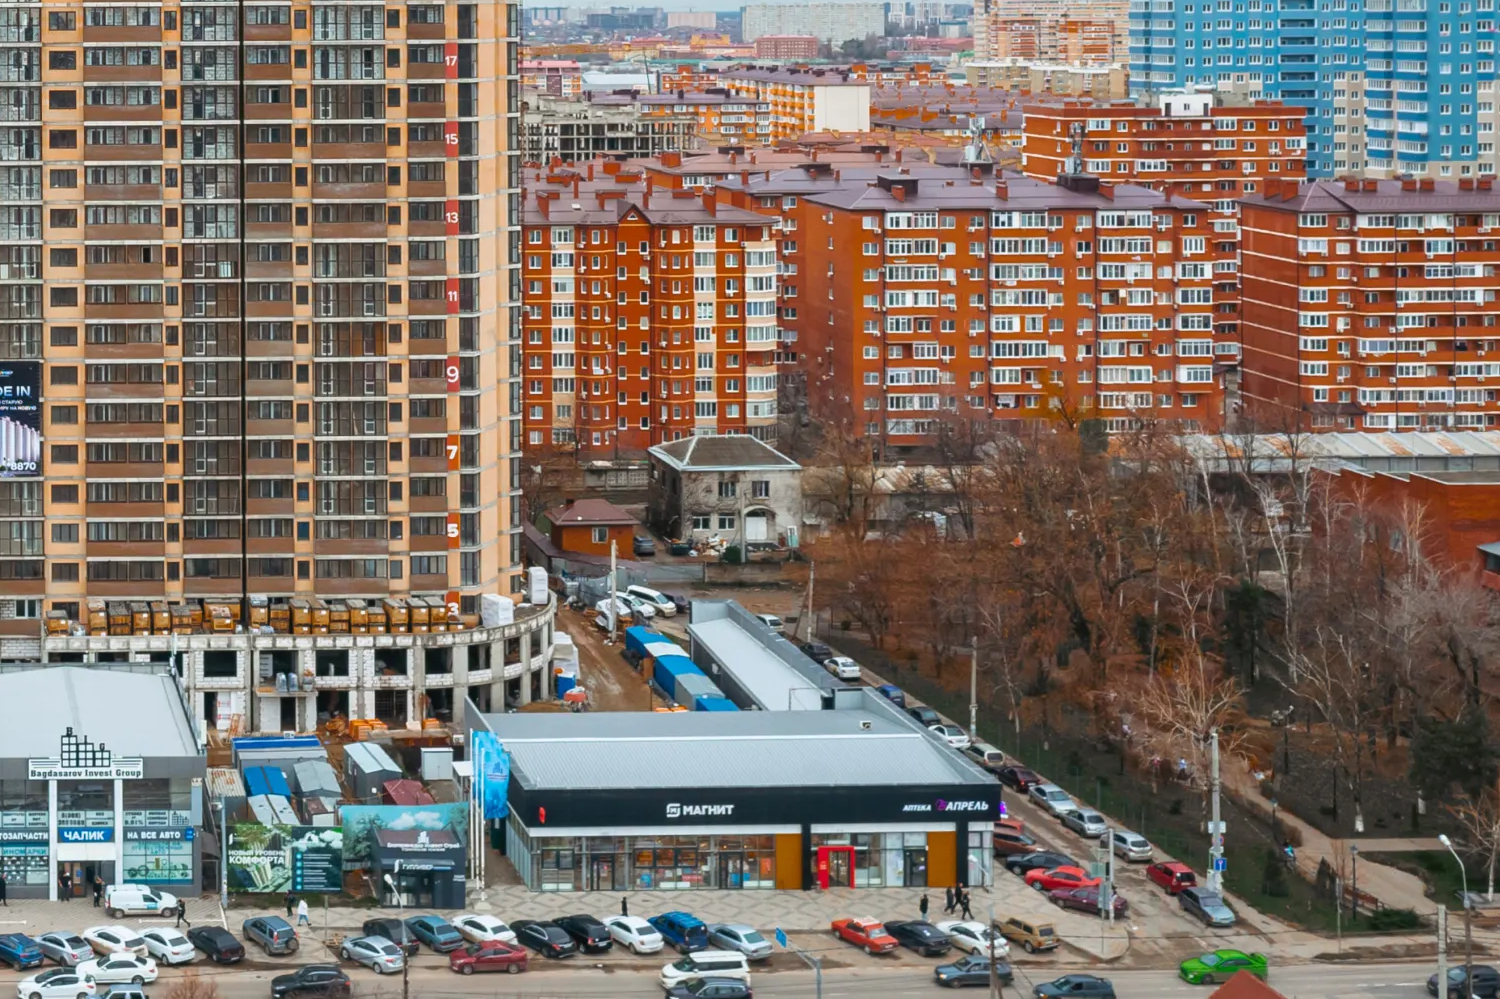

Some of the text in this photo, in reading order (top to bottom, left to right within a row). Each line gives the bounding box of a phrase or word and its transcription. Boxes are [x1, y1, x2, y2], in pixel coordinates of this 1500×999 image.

[445, 56, 457, 66] 17
[445, 134, 458, 144] 15
[445, 212, 458, 223] 13
[448, 291, 458, 301] 11
[446, 366, 459, 382] 9
[16, 386, 31, 397] IN
[446, 445, 458, 460] 7
[447, 524, 458, 537] 5
[448, 603, 458, 616] 3
[30, 769, 141, 778] Bagdasarov Invest Group
[682, 804, 735, 816] МАГНИТ
[902, 801, 989, 812] АПТЕКА АПРЕЛЬ
[63, 830, 105, 841] ЧАЛИК
[127, 831, 139, 839] НА
[141, 831, 156, 839] ВСЕ
[159, 831, 181, 839] АВТО
[228, 856, 285, 864] КОМФОРТА
